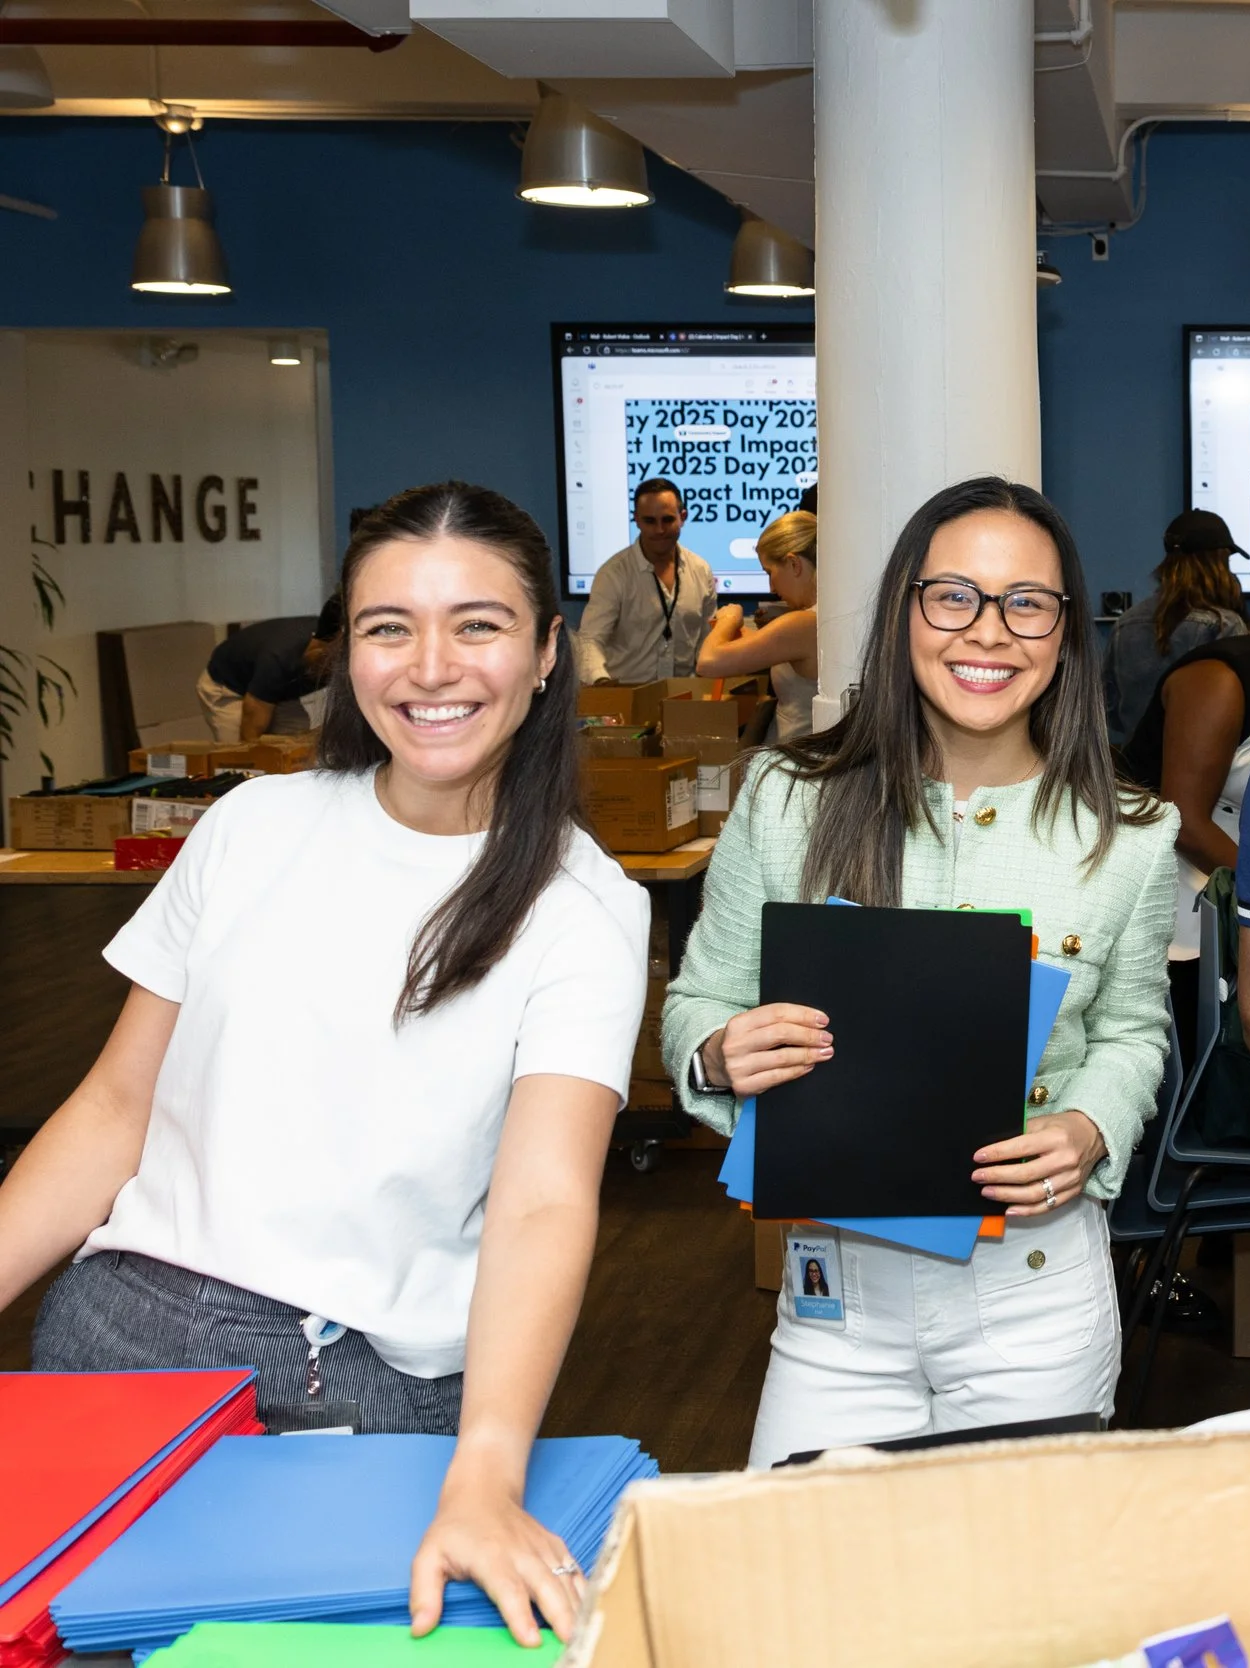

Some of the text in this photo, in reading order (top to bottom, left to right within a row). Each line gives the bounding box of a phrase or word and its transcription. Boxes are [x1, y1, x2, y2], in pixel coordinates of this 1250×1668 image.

[655, 409, 715, 428] 2025
[723, 409, 769, 434] Day
[652, 434, 731, 459] Impact
[657, 456, 716, 475] 2025
[725, 456, 770, 481] Day
[28, 469, 261, 544] HANGE
[682, 484, 732, 507] pact
[689, 503, 718, 523] 25
[726, 504, 771, 529] Day
[803, 1244, 827, 1253] PayPal
